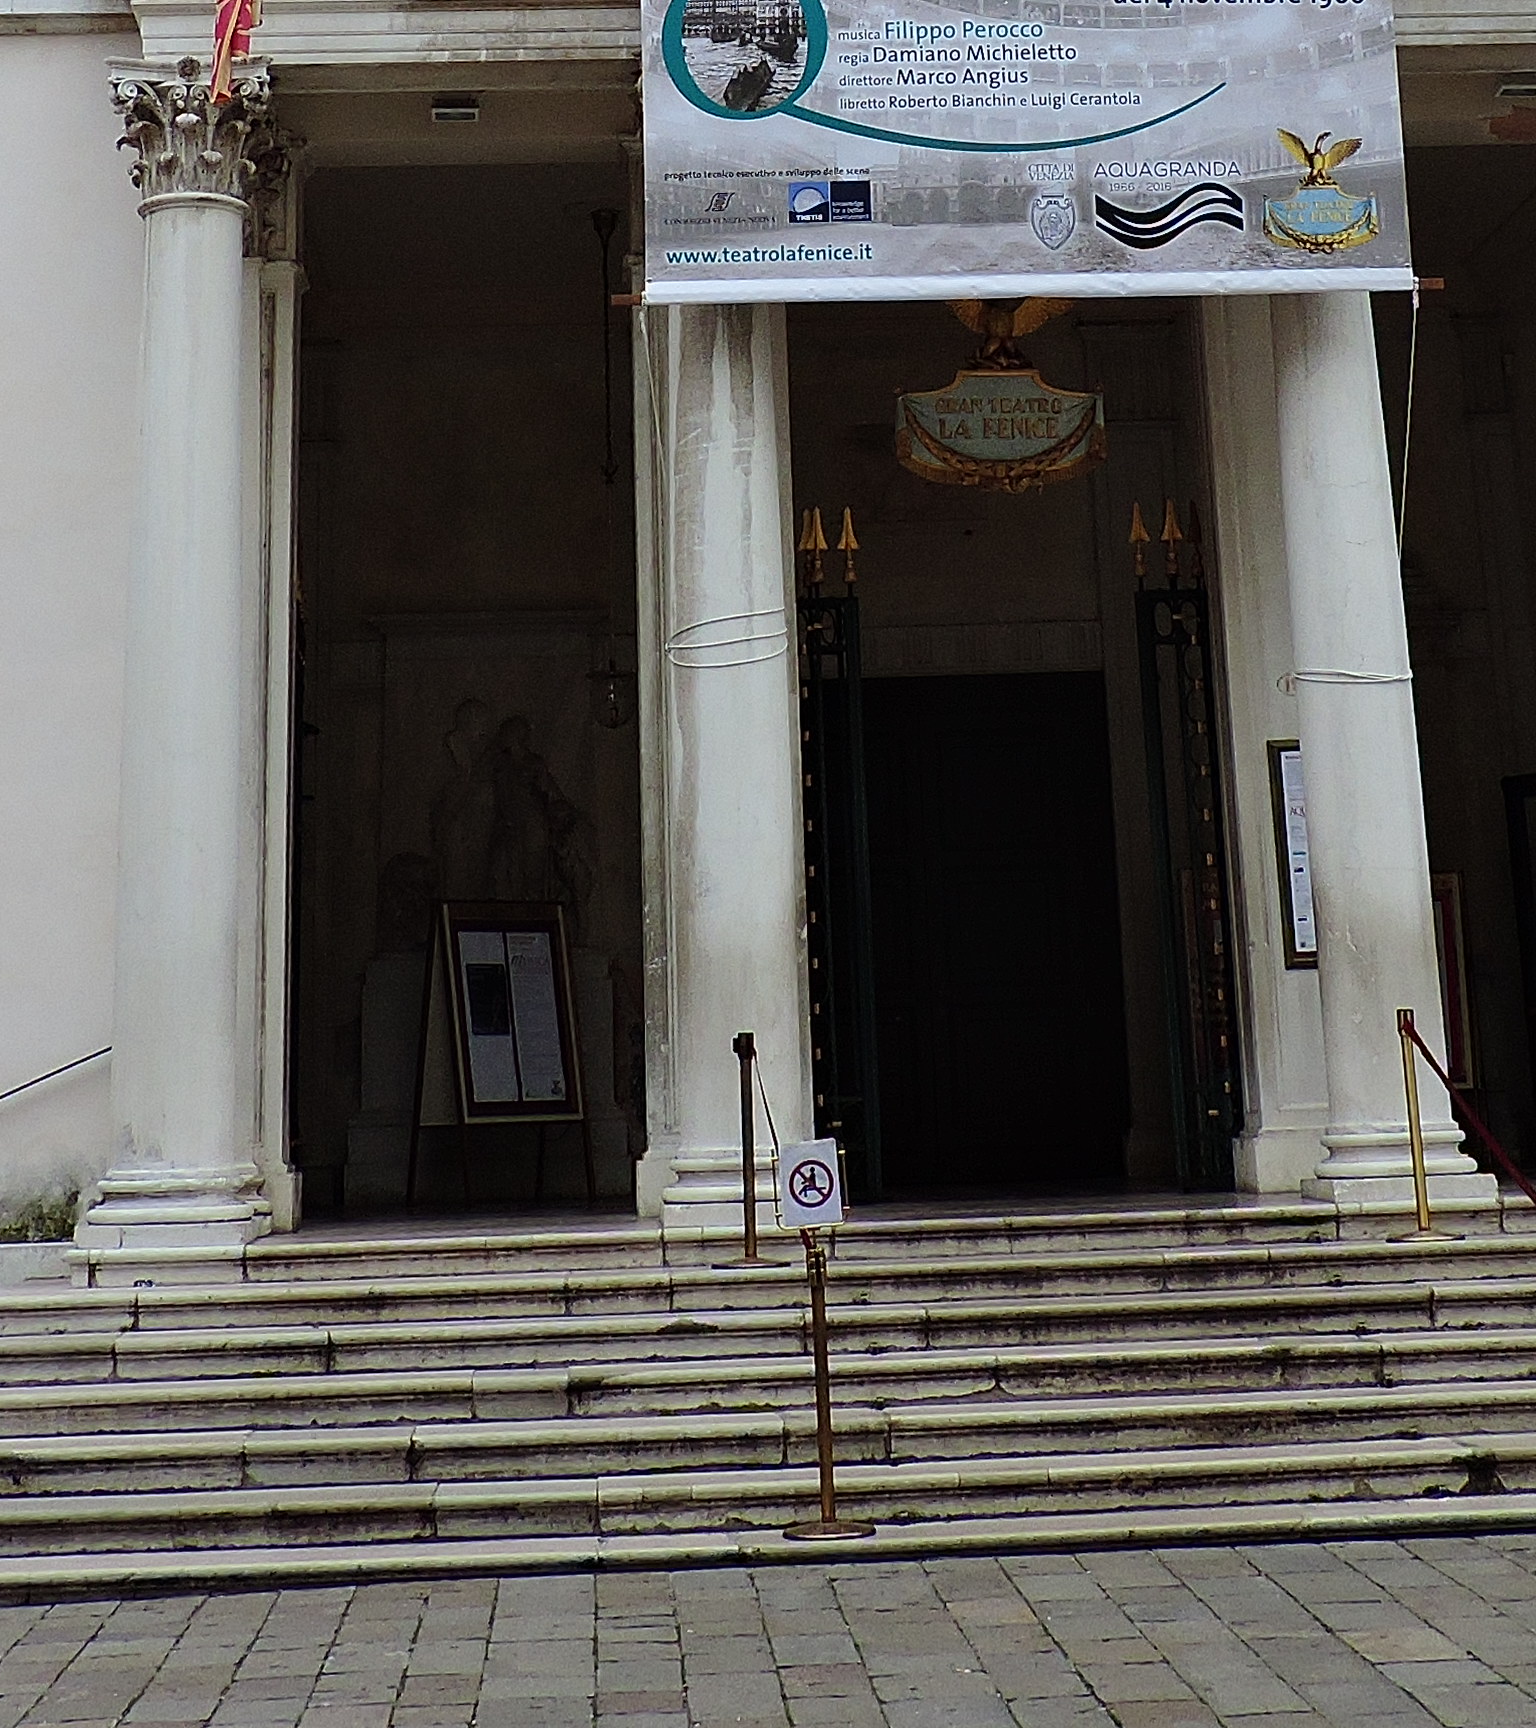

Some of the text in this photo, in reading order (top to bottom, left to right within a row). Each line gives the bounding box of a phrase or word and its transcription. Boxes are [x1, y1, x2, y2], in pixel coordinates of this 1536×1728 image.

[837, 20, 1044, 44] musica Filippo Perocco
[838, 44, 1077, 67] regia Damiano Michieletto
[838, 67, 1029, 89] direttore Marco Angius
[839, 90, 1141, 111] libretto Roberto Bianchin e Luigi Cerantola
[1028, 172, 1075, 181] VENEZIA
[1094, 161, 1242, 178] AQUAGRANDA
[666, 244, 873, 264] www.teatrolafenice.it
[938, 417, 1061, 440] LA FENICE
